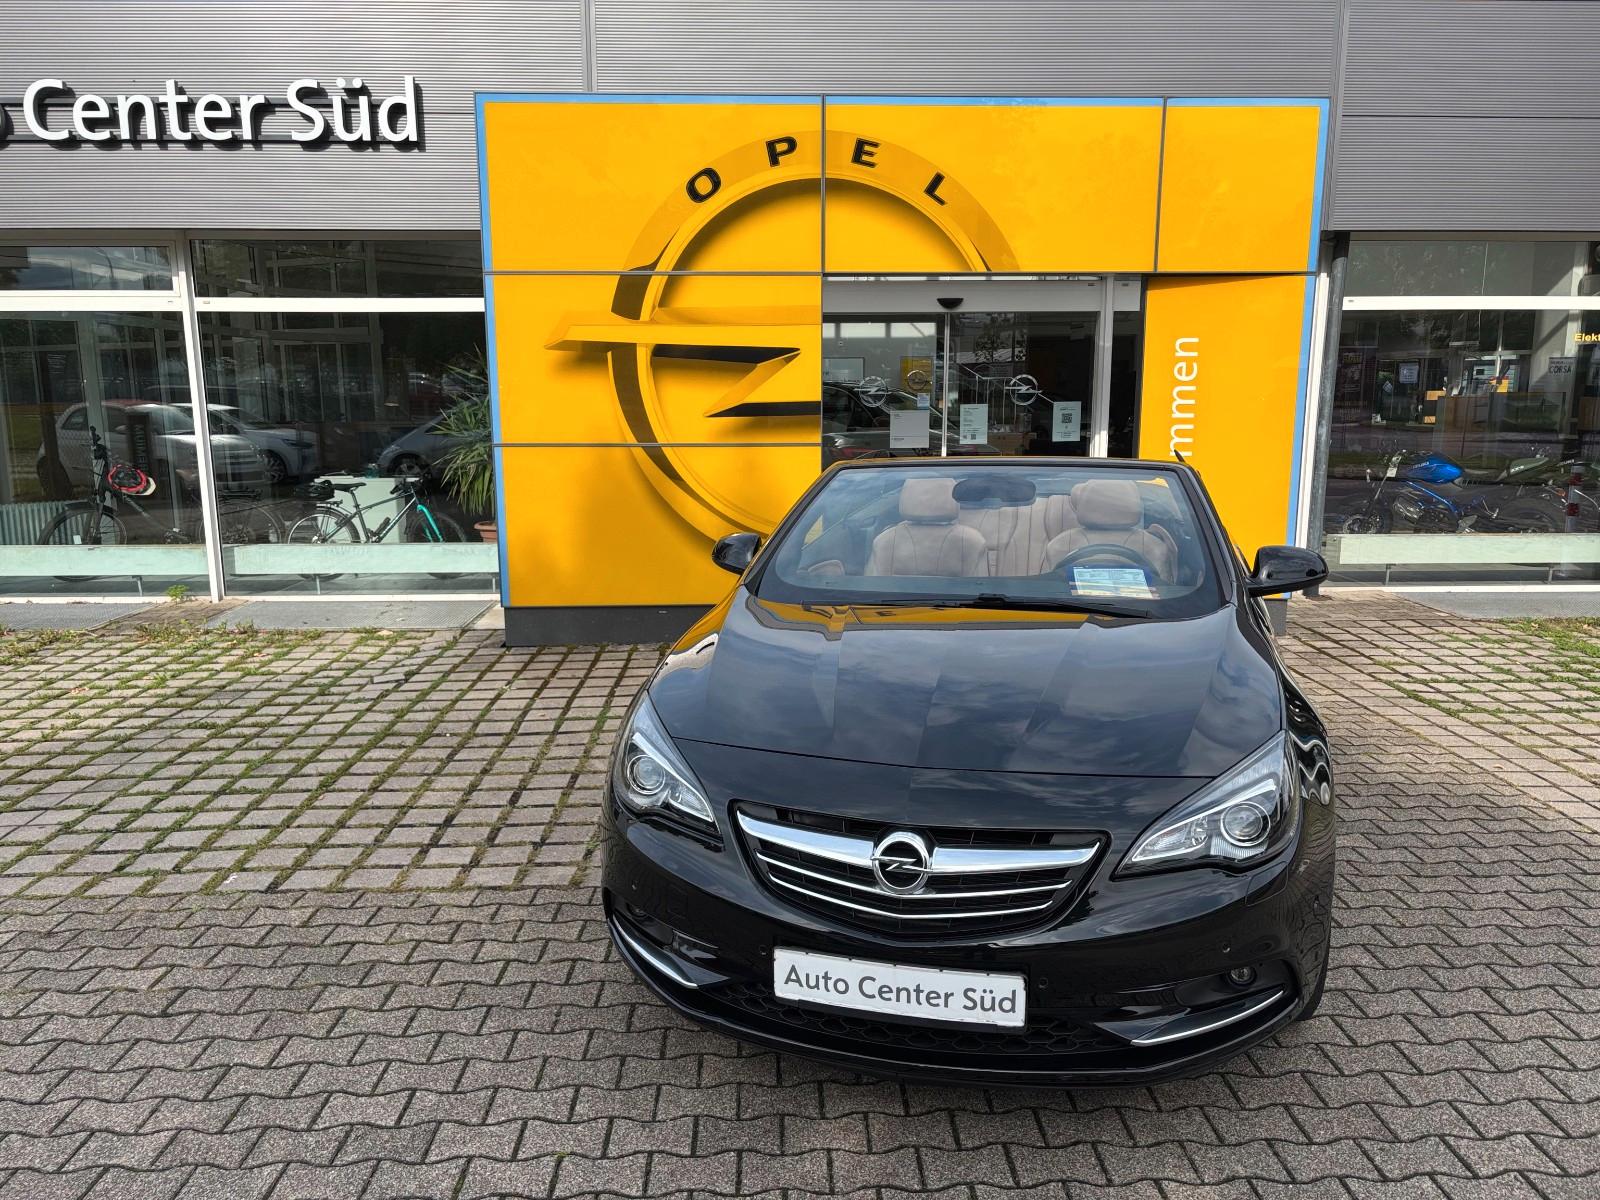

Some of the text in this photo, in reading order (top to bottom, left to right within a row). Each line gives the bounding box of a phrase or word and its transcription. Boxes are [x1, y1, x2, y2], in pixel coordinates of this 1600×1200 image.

[23, 75, 419, 142] Center Süd
[686, 136, 948, 206] OPEL
[784, 964, 1017, 1014] Auto Center Süd
